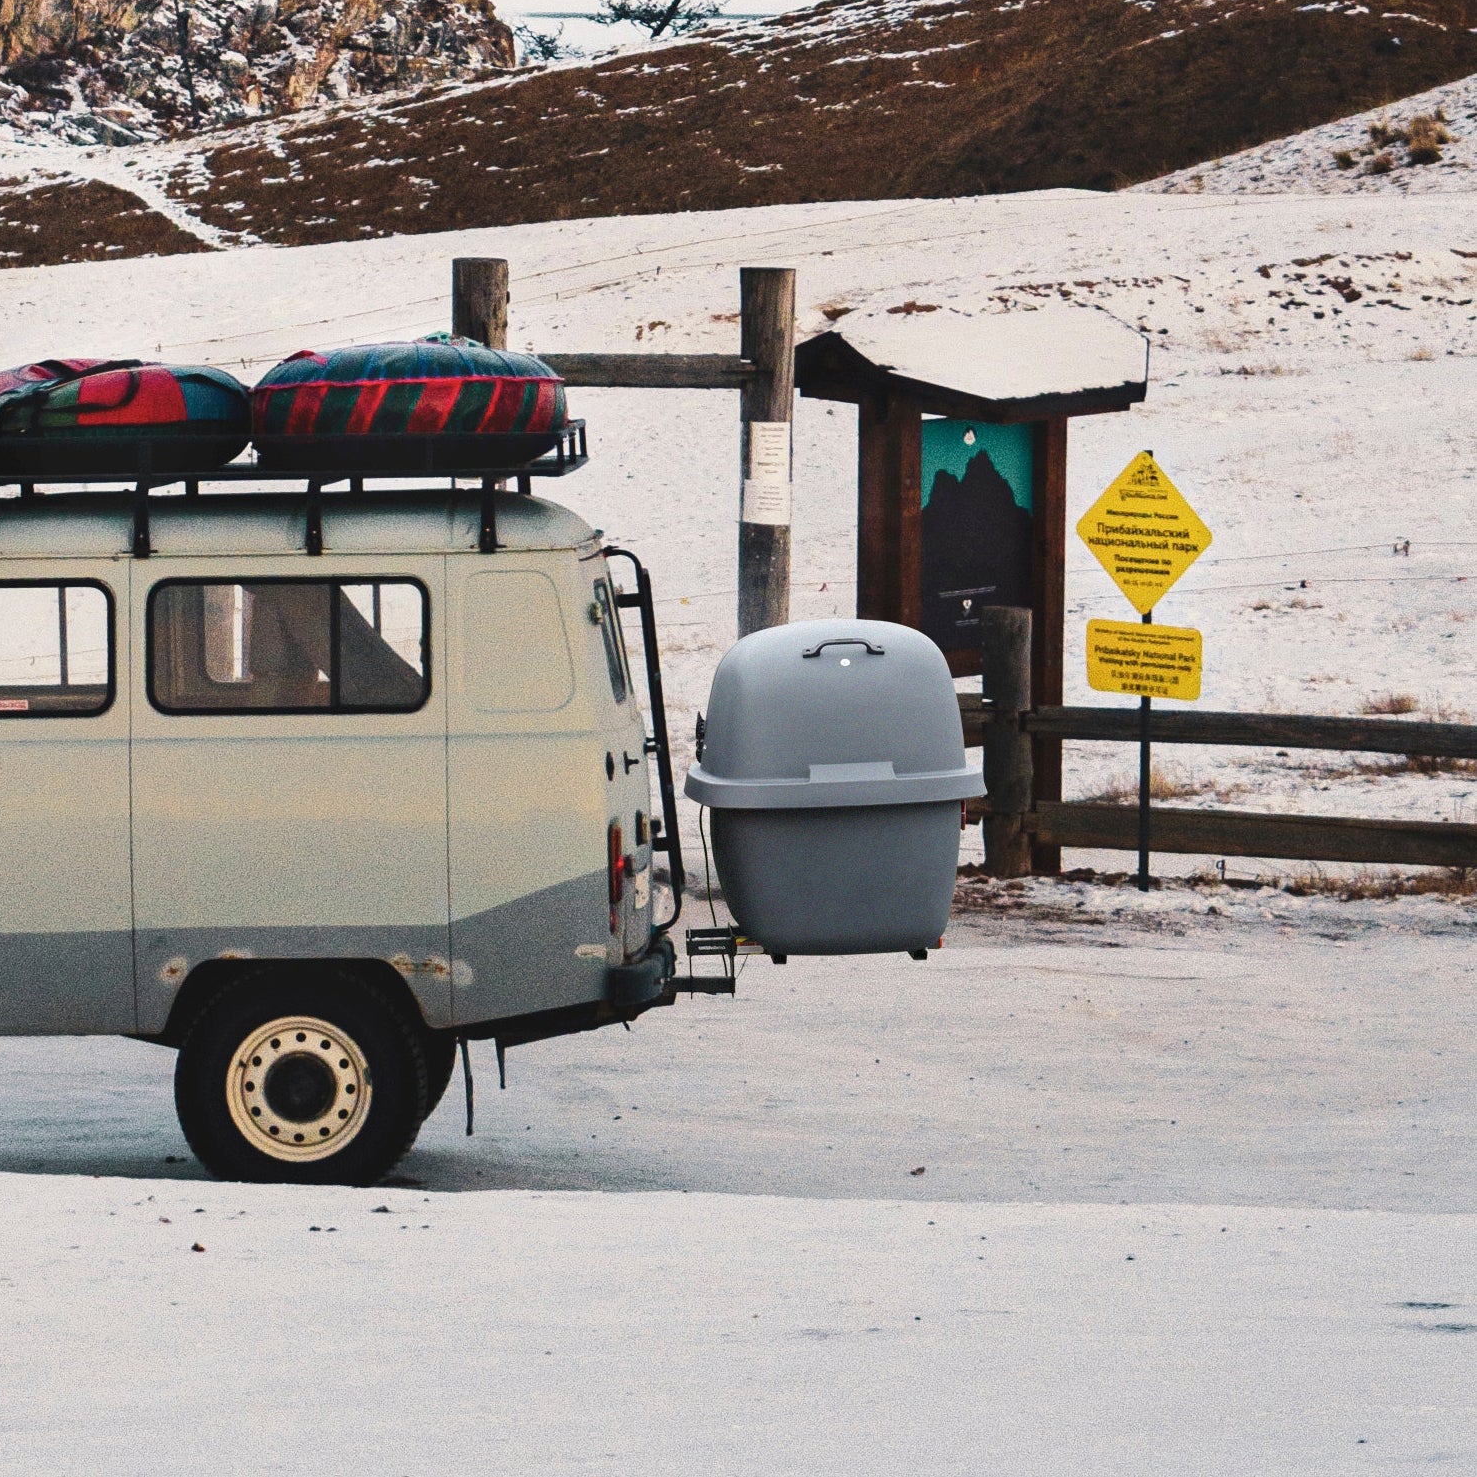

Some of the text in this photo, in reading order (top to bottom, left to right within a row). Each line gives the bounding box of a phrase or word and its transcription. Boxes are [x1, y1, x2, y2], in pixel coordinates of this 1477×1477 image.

[1097, 522, 1190, 539] Прибайкальский
[1088, 536, 1199, 554] национальный парк
[1142, 650, 1176, 661] National
[1178, 652, 1196, 663] Park
